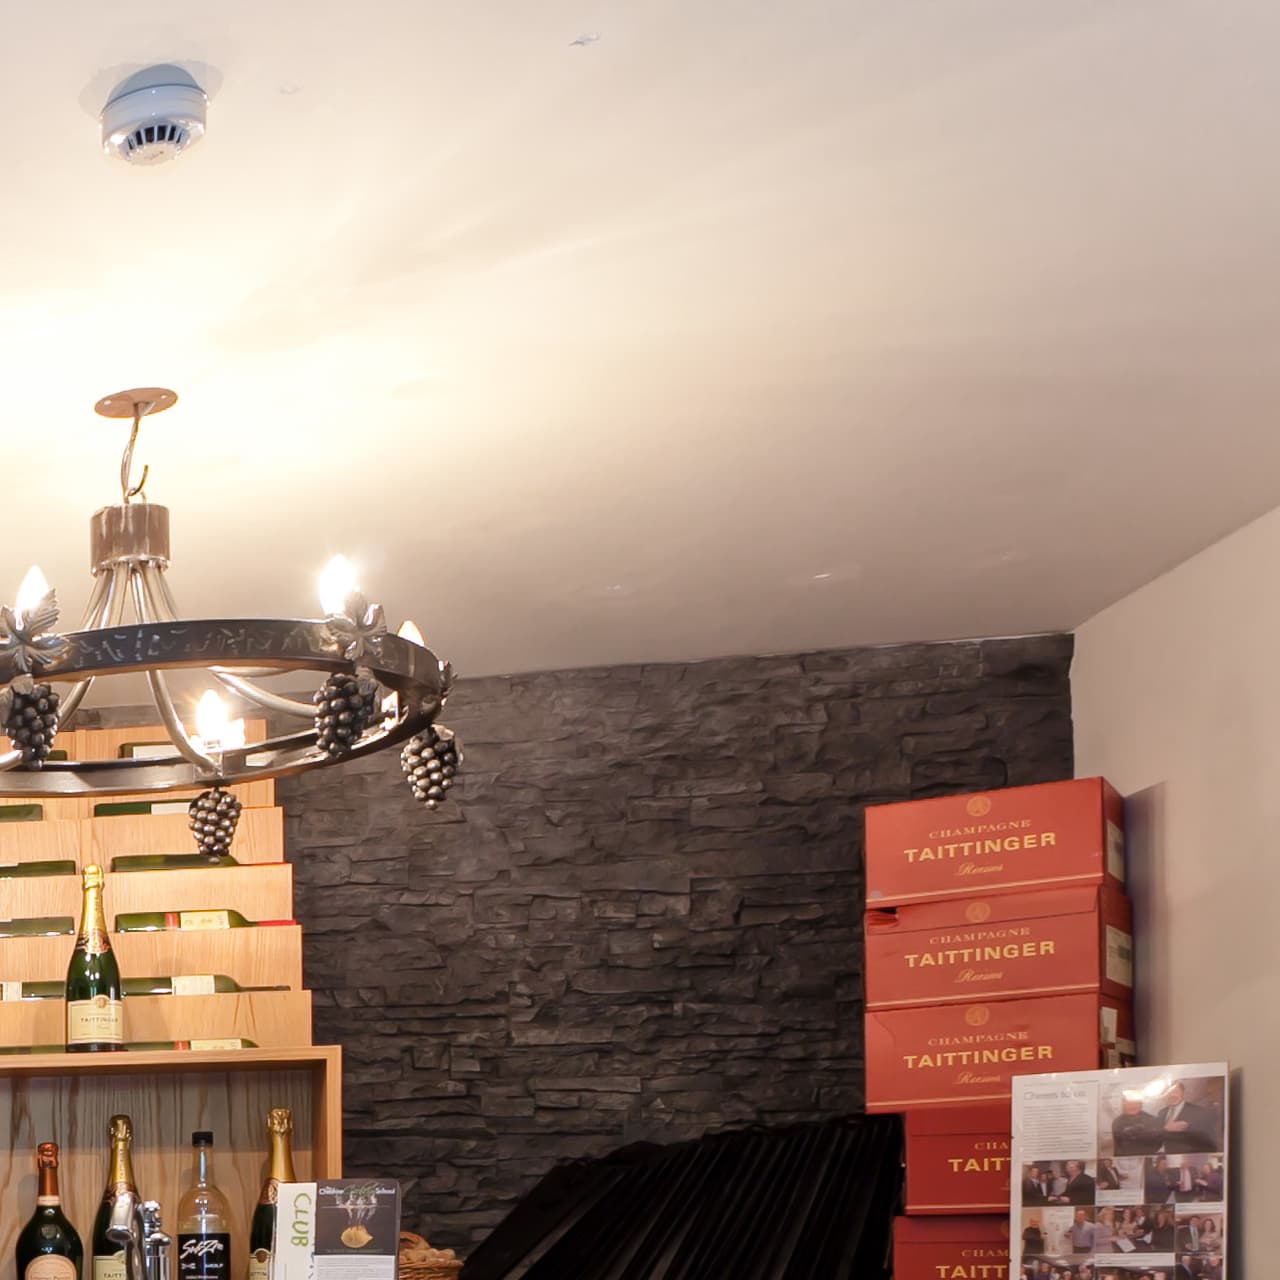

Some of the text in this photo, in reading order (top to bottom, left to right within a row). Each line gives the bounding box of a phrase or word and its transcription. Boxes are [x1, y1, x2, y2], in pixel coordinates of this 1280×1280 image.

[929, 819, 1032, 840] CHAMPAGNE
[903, 831, 1057, 863] TAITTINGER
[929, 927, 1031, 945] CHAMPAGNE
[903, 940, 1056, 968] TAITTINGER
[927, 1031, 1028, 1046] CHAMPAGNE
[903, 1045, 1053, 1069] TAITTINGER
[291, 1192, 311, 1247] CLUB
[936, 1265, 1009, 1278] TAITT
